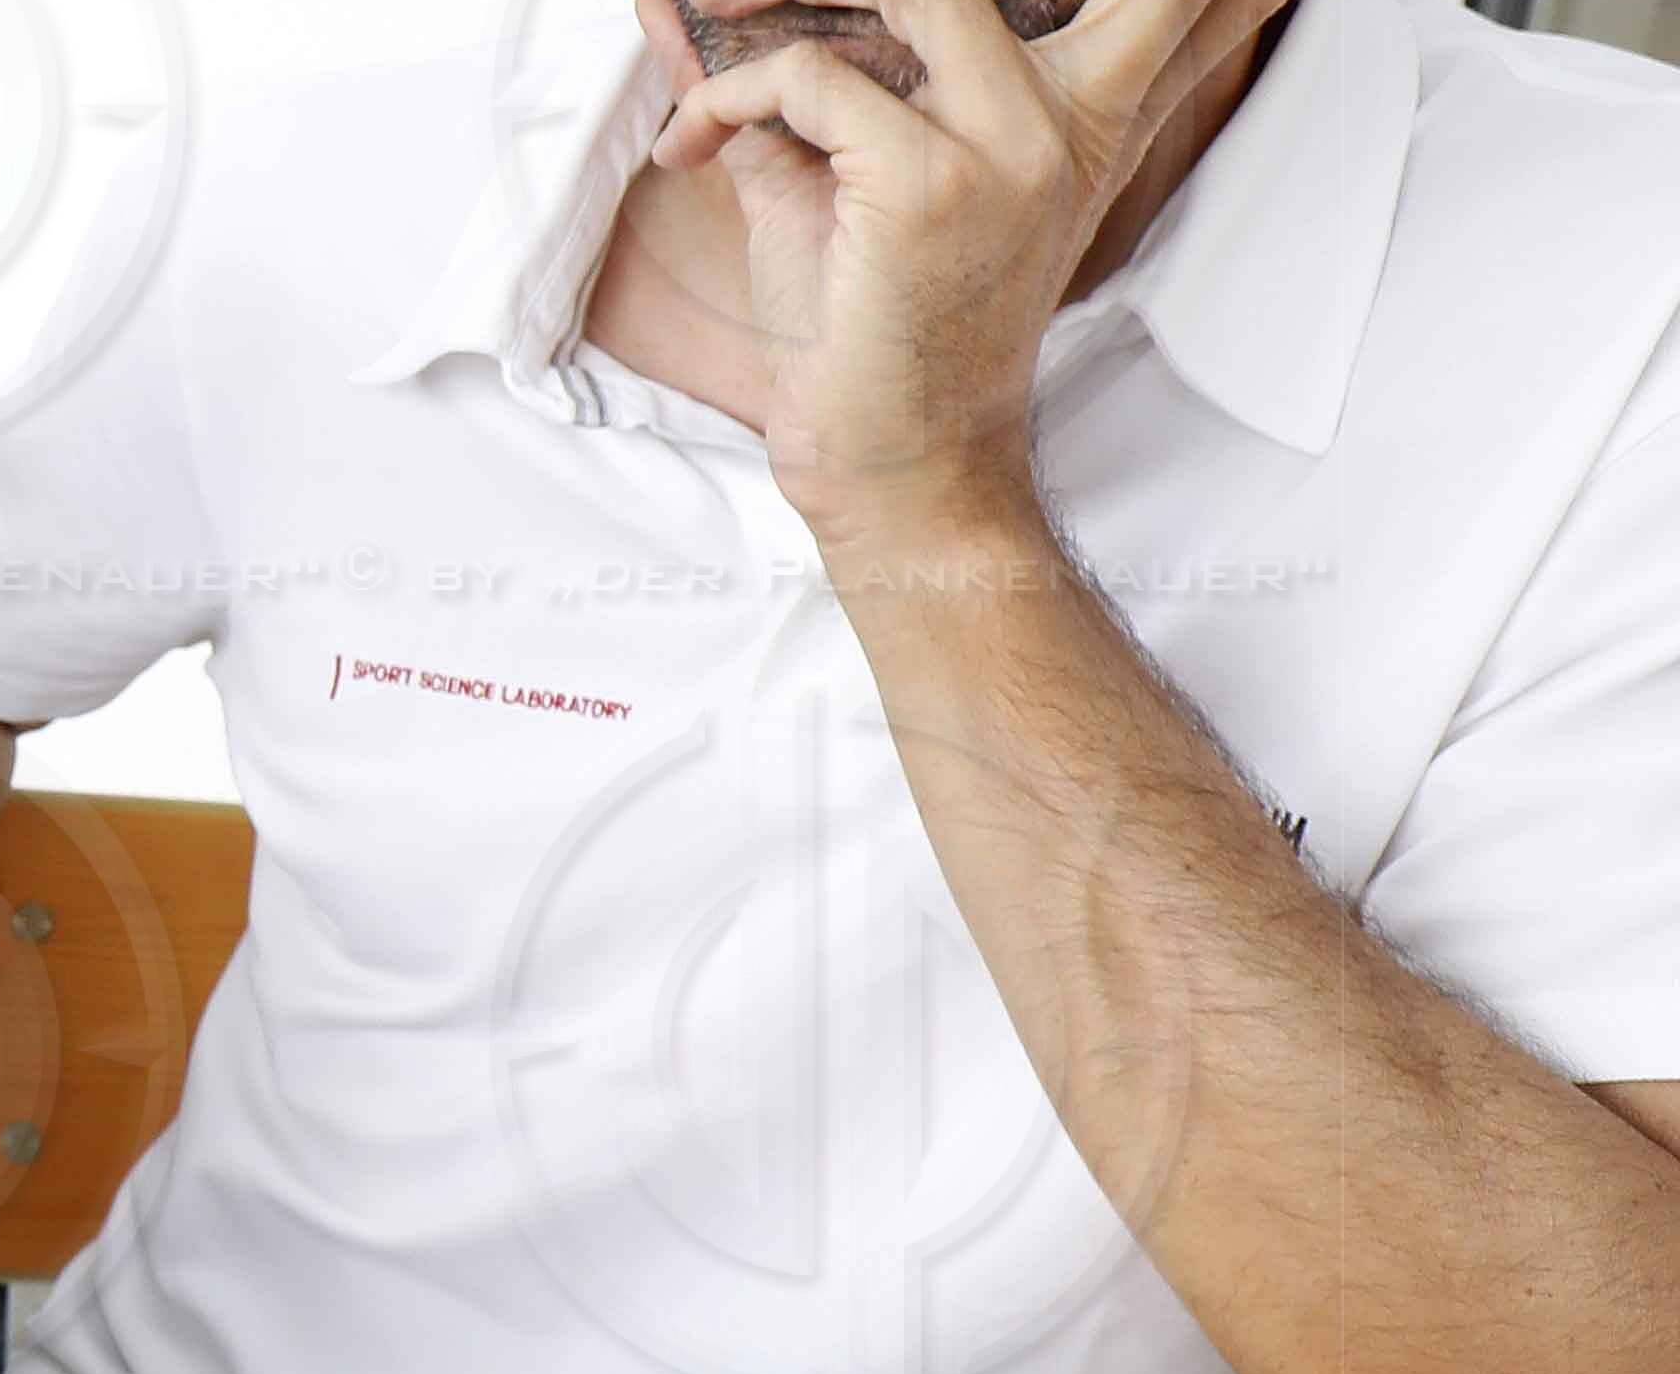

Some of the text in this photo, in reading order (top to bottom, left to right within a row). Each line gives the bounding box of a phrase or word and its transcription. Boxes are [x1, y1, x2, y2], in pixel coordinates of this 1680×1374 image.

[352, 659, 633, 721] SPORT SCIENCE LABORATORY
